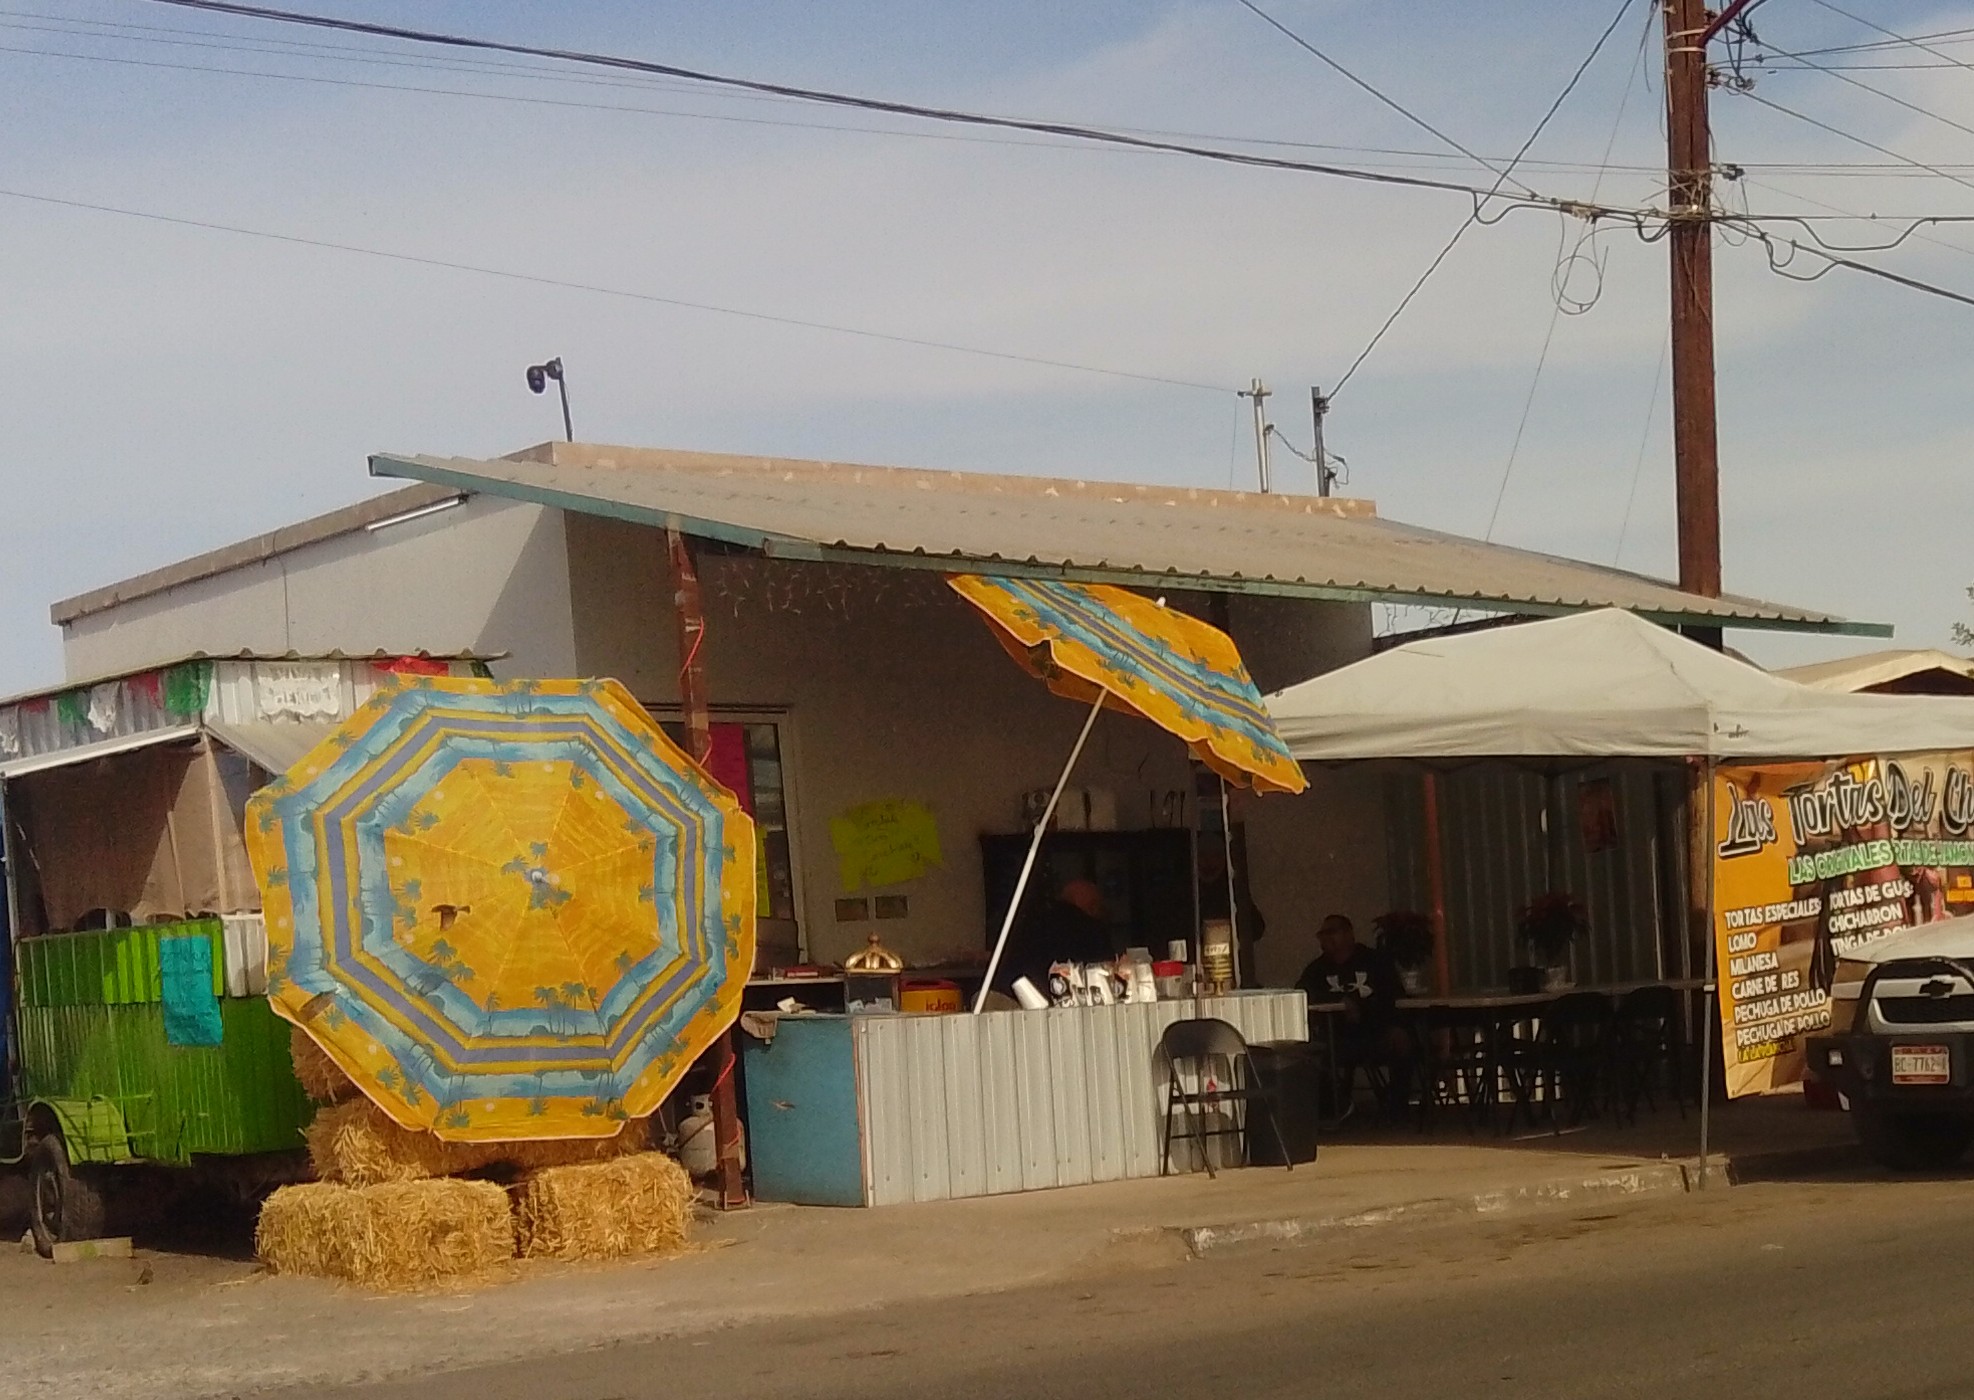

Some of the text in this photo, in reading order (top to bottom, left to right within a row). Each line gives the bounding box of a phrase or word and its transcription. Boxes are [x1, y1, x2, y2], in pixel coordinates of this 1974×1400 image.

[1719, 782, 1776, 857] Las
[1780, 771, 1883, 846] Tortas
[1887, 760, 1936, 830] Del
[1789, 854, 1816, 885] LAS
[1864, 884, 1881, 904] DE
[1725, 906, 1763, 929] TORTAS
[1828, 901, 1904, 934] CHICHARRON
[1728, 932, 1757, 954] LOMO
[1730, 951, 1779, 976] MILANESA
[1731, 970, 1800, 1000] CARNE DE RES
[1734, 988, 1827, 1024] PECHUGA DE POLLO
[1737, 1011, 1831, 1047] PECHUGA DE POLLO
